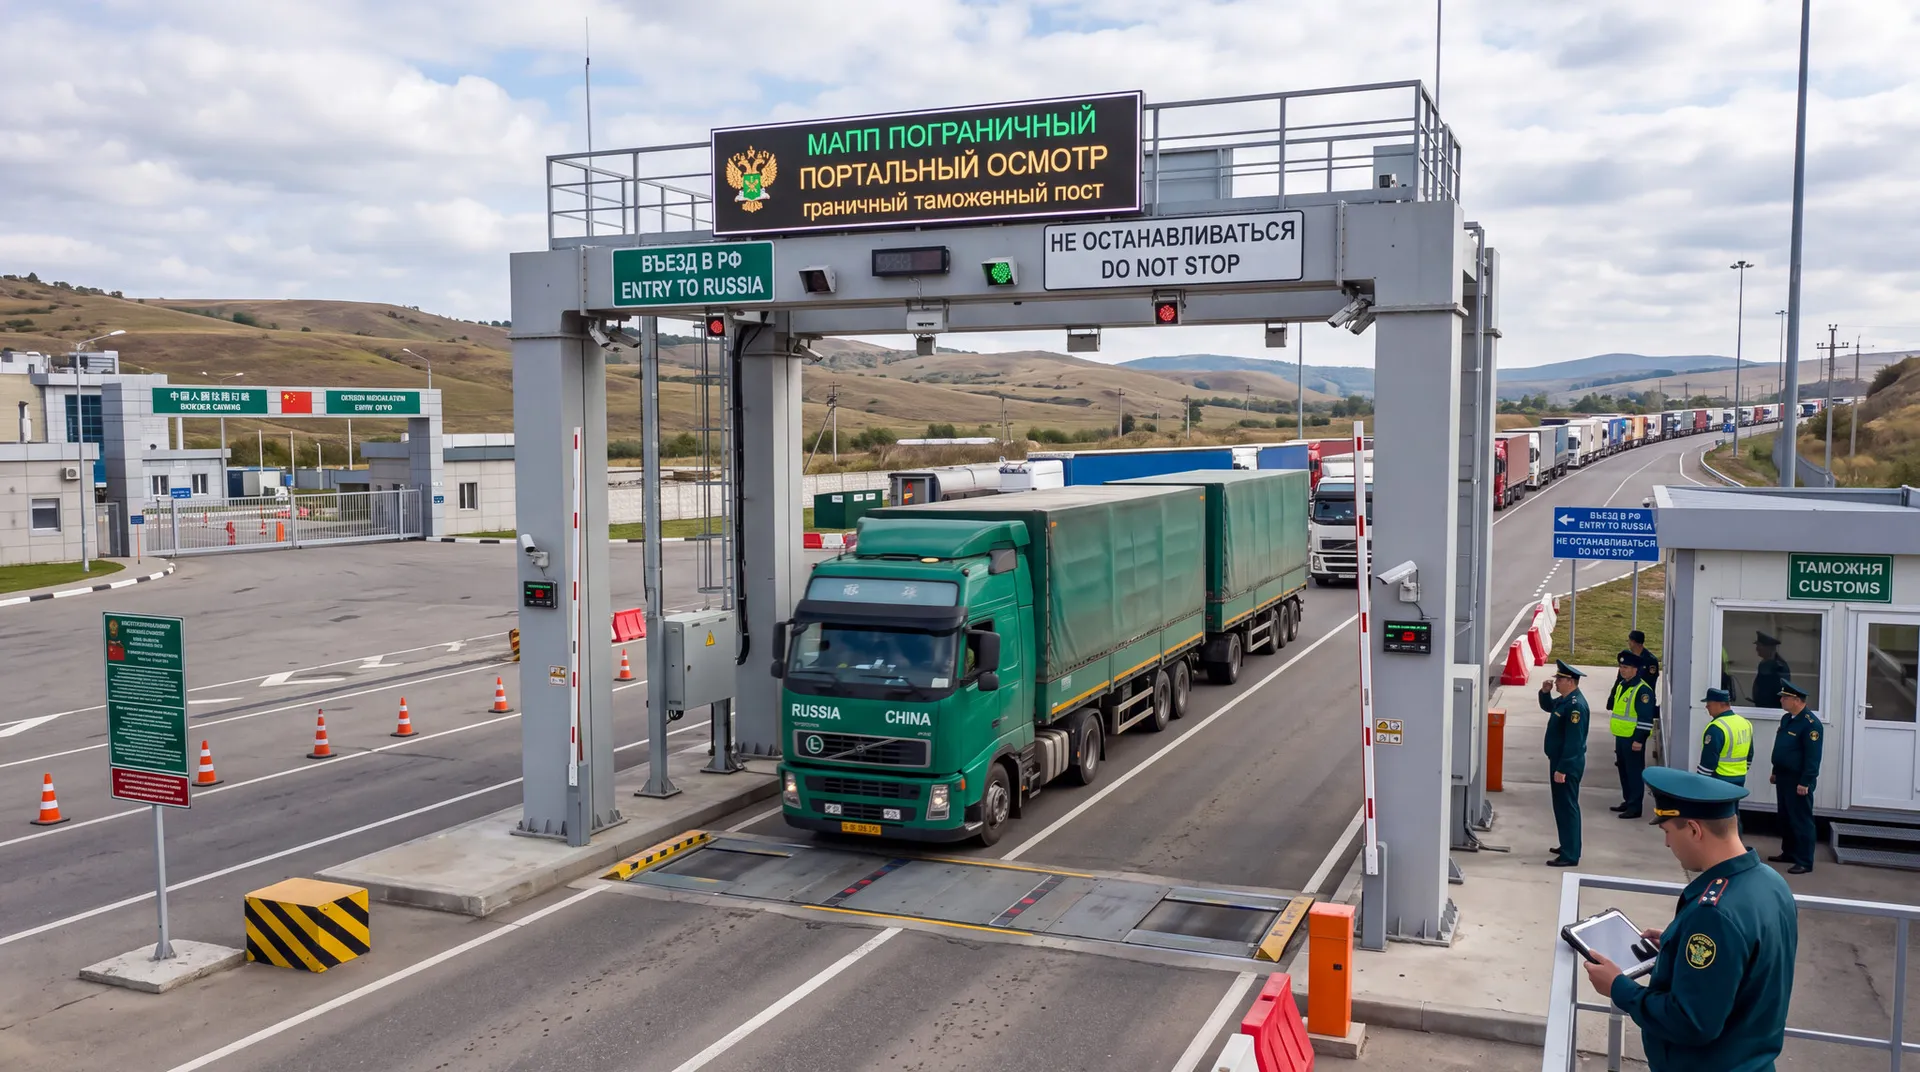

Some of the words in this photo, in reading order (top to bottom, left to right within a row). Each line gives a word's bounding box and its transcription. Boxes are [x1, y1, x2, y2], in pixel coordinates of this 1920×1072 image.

[807, 127, 880, 156] МАПП
[888, 103, 1096, 150] ПОГРАНИЧНЫЙ
[799, 148, 979, 190] ПОРТАЛЬНЫЙ
[987, 144, 1109, 177] ОСМОТР
[803, 191, 908, 222] граничный
[913, 181, 1048, 211] таможенный
[1054, 182, 1105, 201] пост
[1050, 232, 1077, 252] НЕ
[1082, 220, 1296, 251] ОСТАНАВЛИВАТЬСЯ
[641, 252, 698, 275] ВЪЕЗД
[701, 252, 714, 270] В
[717, 250, 742, 270] РФ
[1101, 259, 1130, 279] DO
[1136, 257, 1179, 278] NOT
[1184, 253, 1241, 275] STOP
[621, 279, 673, 300] ENTRY
[677, 278, 699, 297] TO
[703, 275, 765, 296] RUSSIA
[1620, 512, 1628, 520] В
[1579, 520, 1606, 530] ENTRY
[1608, 522, 1620, 530] TO
[1621, 522, 1653, 531] RUSSIA
[1556, 537, 1568, 545] НЕ
[1569, 537, 1656, 548] ОСТАНАВЛИВАТЬСЯ
[1578, 547, 1591, 556] DO
[1592, 548, 1610, 556] NOT
[1611, 548, 1635, 557] STOP
[1796, 560, 1883, 576] ТАМОЖНЯ
[1798, 579, 1881, 595] CUSTOMS
[791, 703, 842, 720] RUSSIA
[885, 710, 932, 726] CHINA
